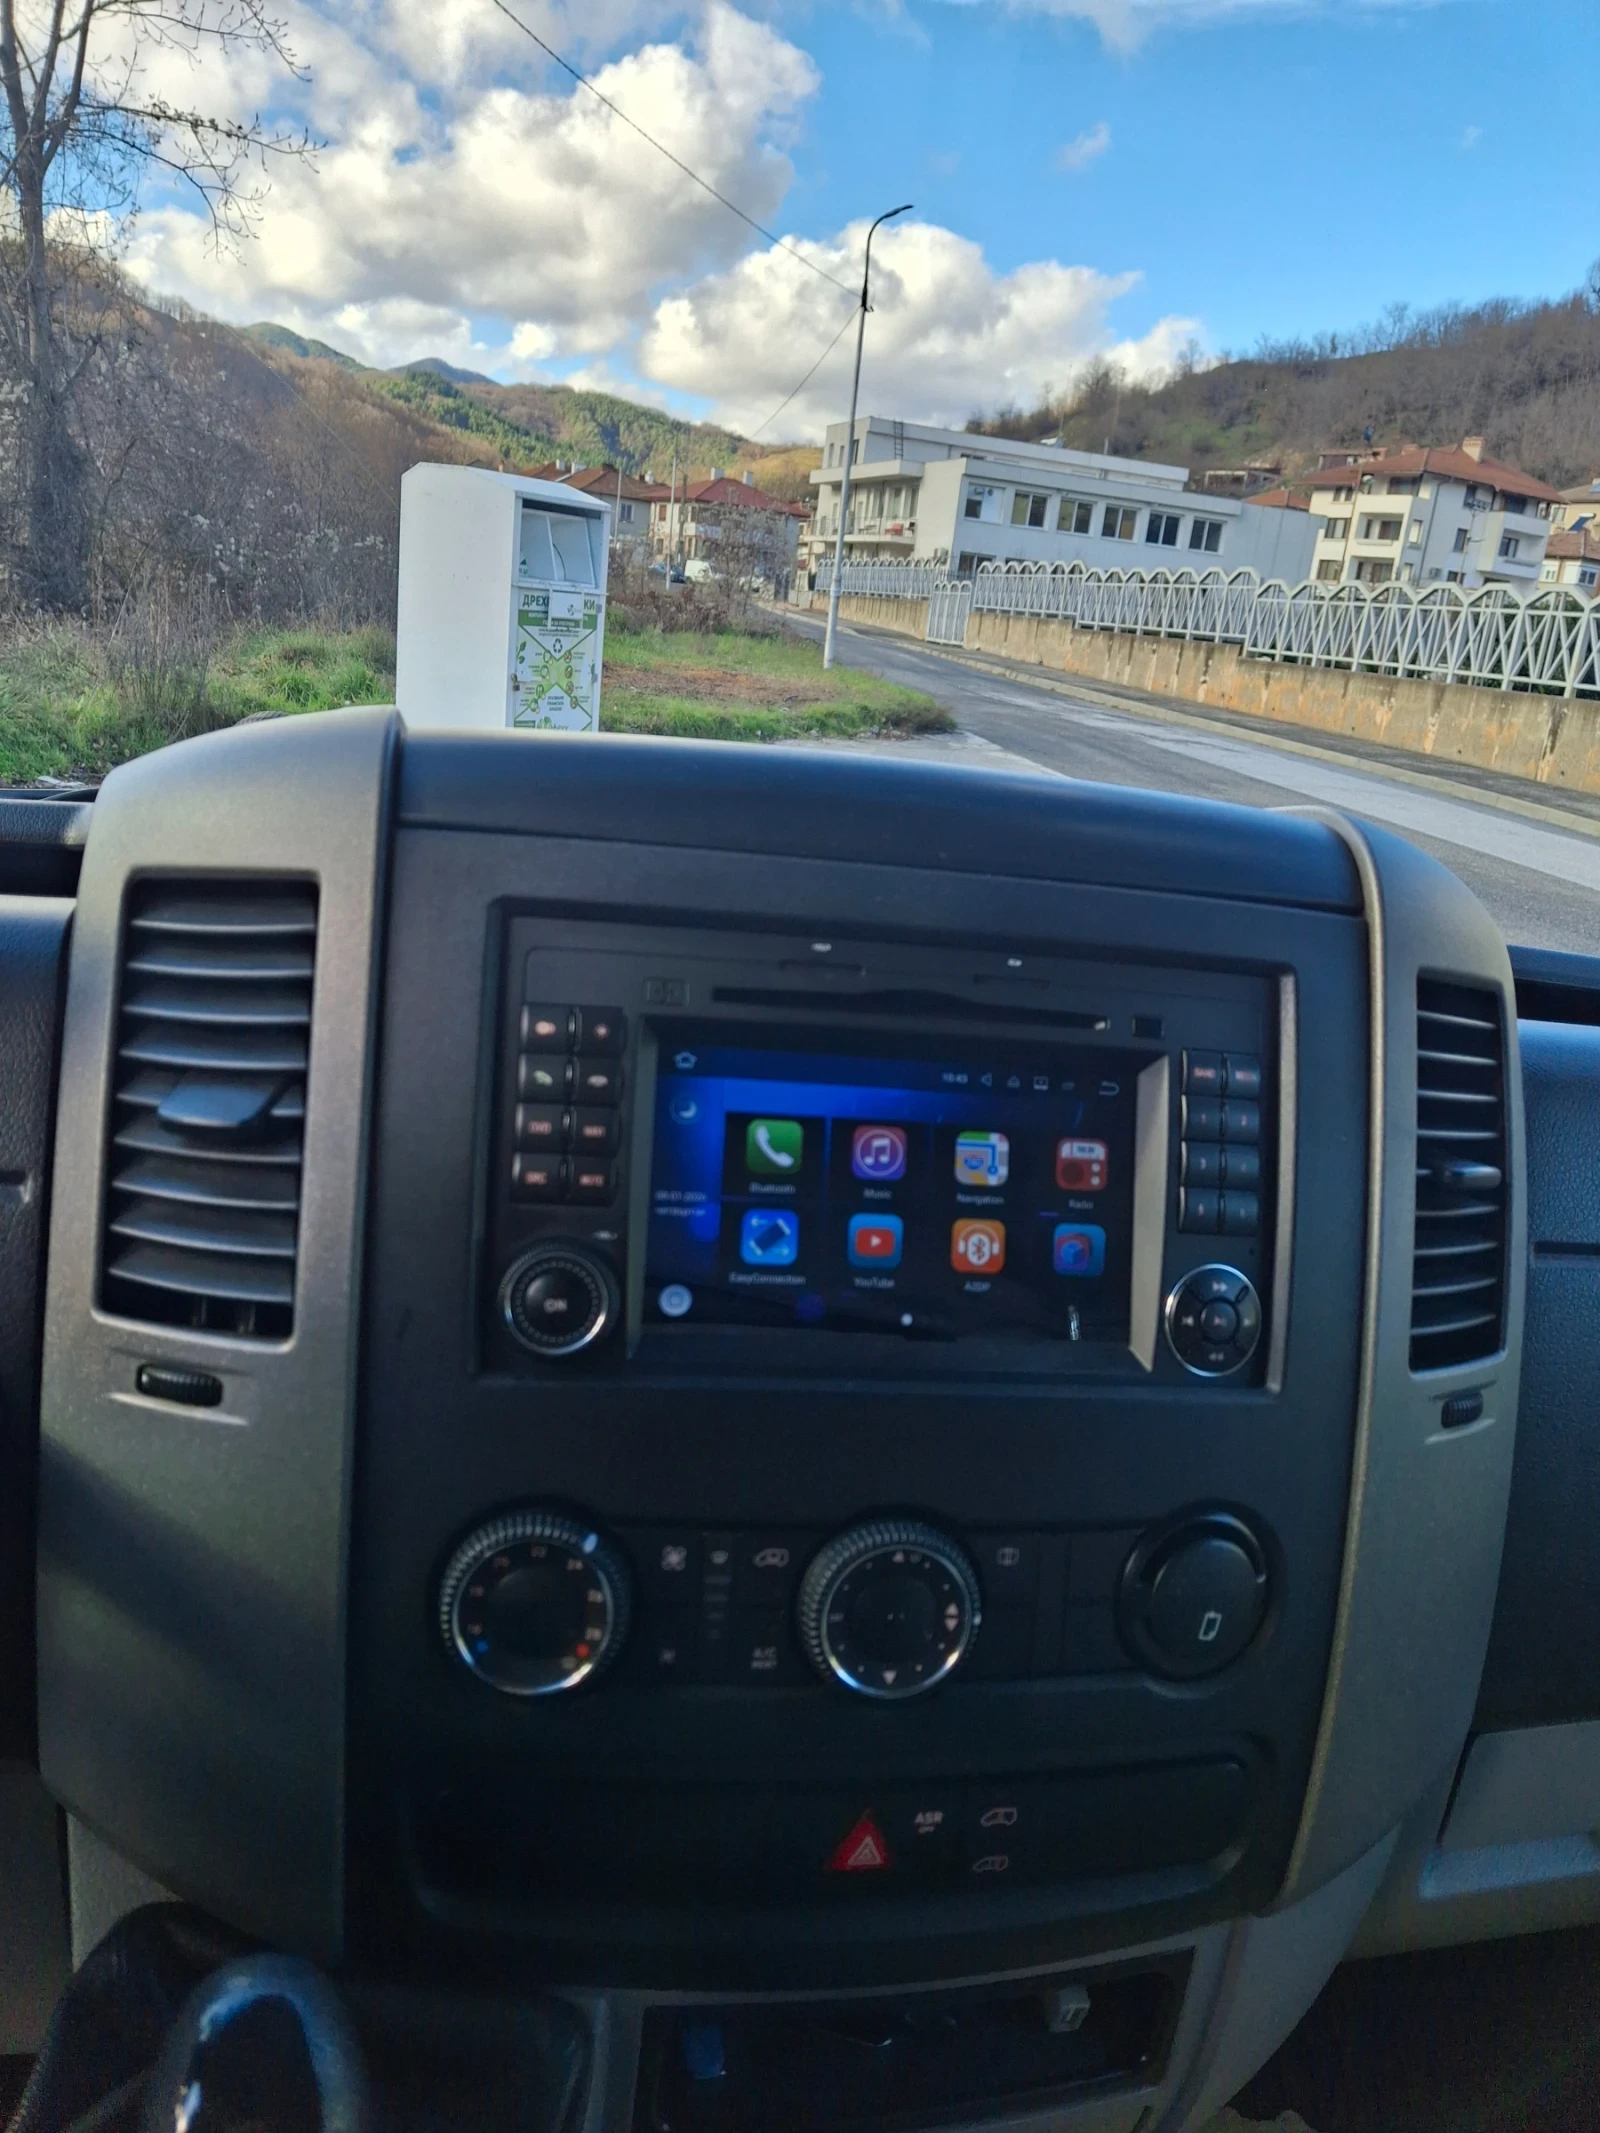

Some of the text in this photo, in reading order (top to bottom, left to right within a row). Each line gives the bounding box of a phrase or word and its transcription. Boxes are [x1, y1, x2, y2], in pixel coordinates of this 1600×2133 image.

[863, 1187, 892, 1199] Music
[956, 1193, 1004, 1206] Navigation
[1068, 1198, 1094, 1210] Radio
[854, 1276, 895, 1288] YouTube
[543, 1298, 568, 1313] ON
[914, 1810, 943, 1824] ASR
